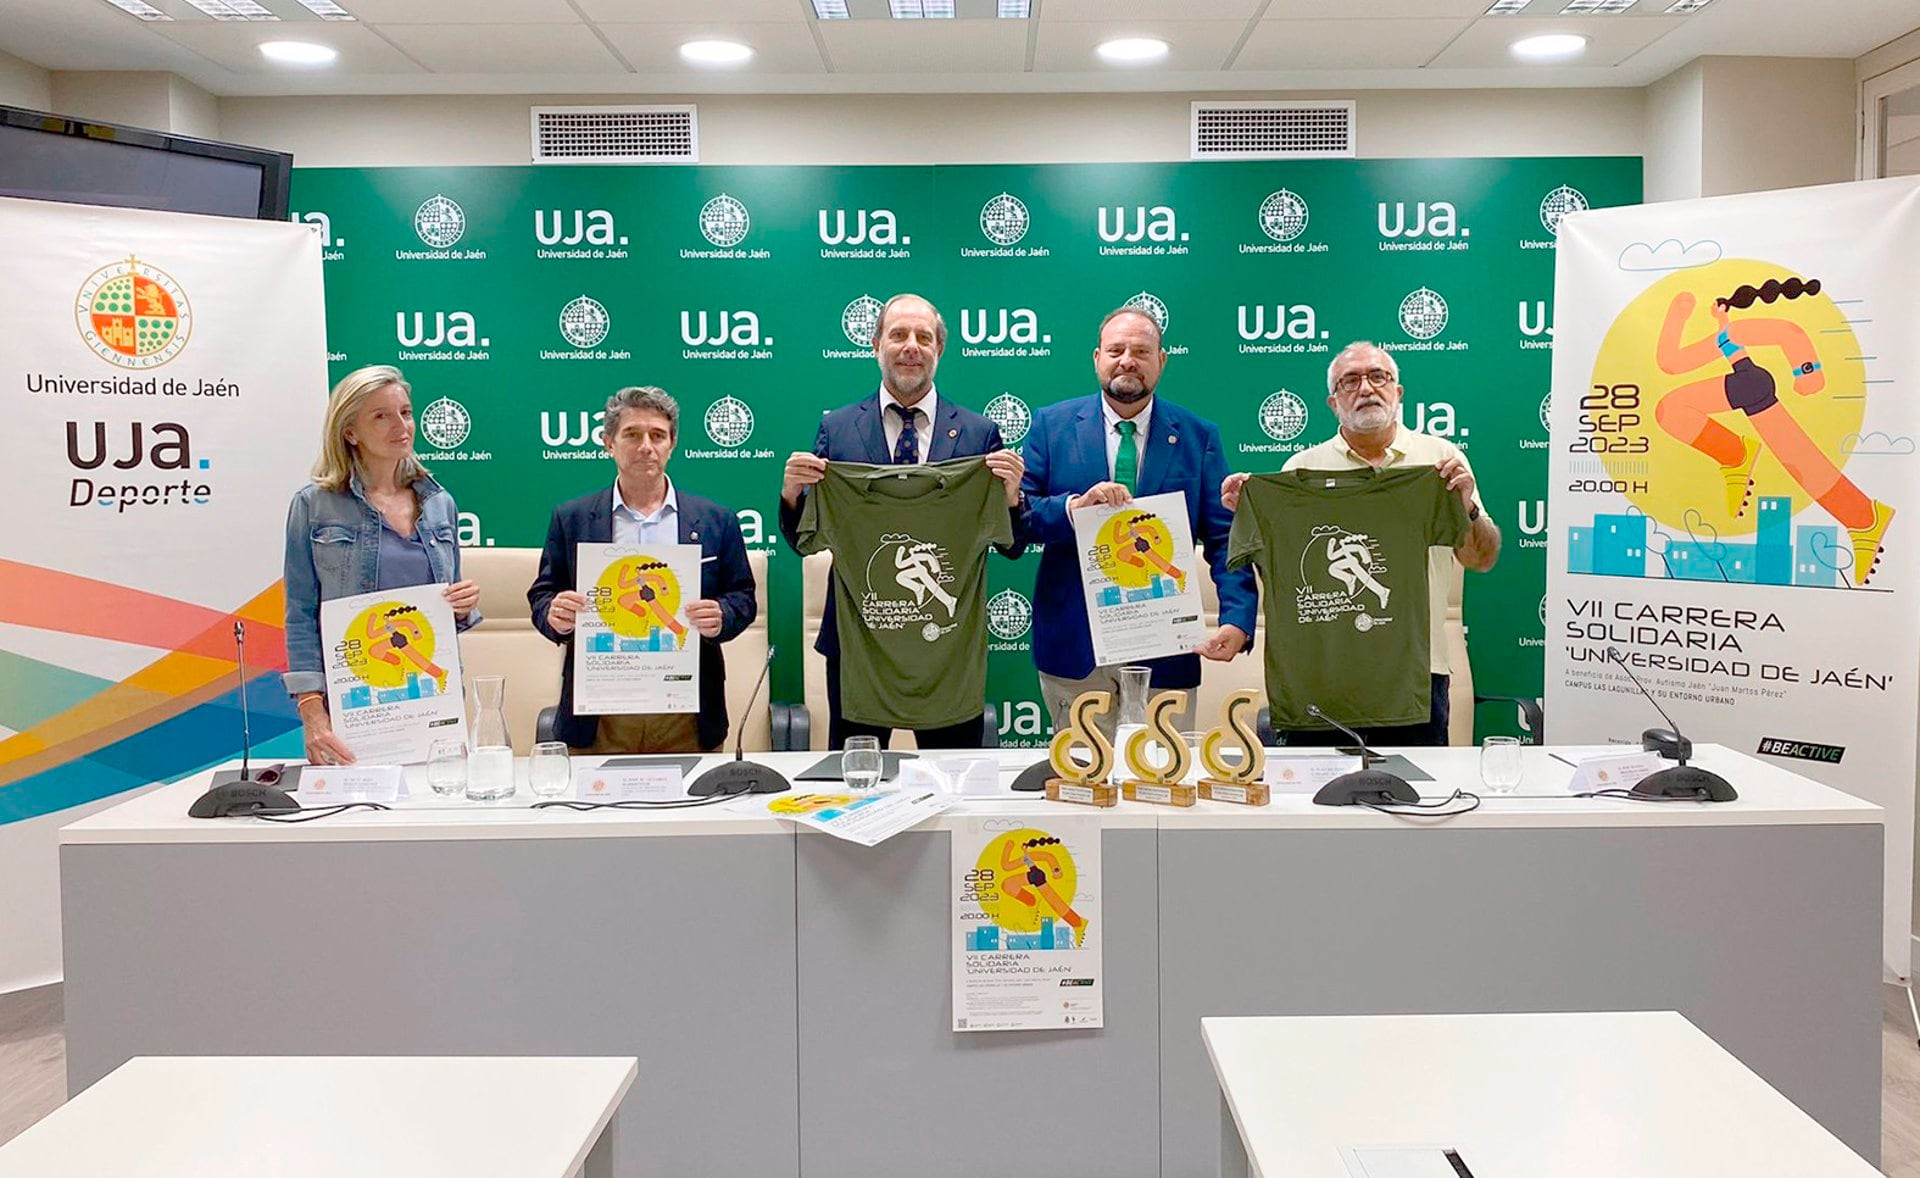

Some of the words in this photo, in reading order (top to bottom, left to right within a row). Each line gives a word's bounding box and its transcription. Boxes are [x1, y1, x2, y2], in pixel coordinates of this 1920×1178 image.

[1100, 246, 1152, 255] Universidad
[1153, 246, 1165, 254] de
[1167, 245, 1188, 254] Jaén
[1239, 243, 1292, 253] Universidad
[1293, 244, 1305, 252] de
[1307, 243, 1328, 252] Jaén
[1379, 241, 1432, 250] Universidad
[1434, 241, 1445, 250] de
[1447, 240, 1468, 250] Jaén
[396, 249, 449, 259] Universidad
[451, 250, 463, 259] de
[464, 250, 486, 259] Jaén
[537, 249, 591, 258] Universidad
[592, 250, 604, 258] de
[606, 249, 627, 258] Jaén
[680, 248, 734, 258] Universidad
[735, 249, 747, 258] de
[748, 249, 770, 258] Jaén
[821, 249, 874, 258] Universidad
[875, 249, 886, 258] de
[888, 249, 910, 258] Jaén
[961, 247, 1014, 256] Universidad
[1015, 248, 1026, 256] de
[1028, 247, 1049, 256] Jaén
[1168, 345, 1188, 354] Jaén
[1239, 344, 1292, 353] Universidad
[1293, 344, 1305, 352] de
[1307, 343, 1328, 352] Jaén
[1379, 341, 1432, 351] Universidad
[1433, 342, 1445, 350] de
[1447, 341, 1468, 350] Jaén
[399, 351, 452, 360] Universidad
[453, 351, 466, 360] de
[467, 351, 489, 360] Jaén
[540, 350, 594, 359] Universidad
[595, 350, 607, 359] de
[609, 350, 630, 359] Jaén
[683, 350, 736, 359] Universidad
[737, 350, 749, 359] de
[751, 350, 772, 358] Jaén
[962, 348, 1014, 357] Universidad
[1015, 348, 1027, 356] de
[1029, 348, 1050, 356] Jaén
[27, 374, 156, 395] Universidad
[163, 378, 187, 396] de
[192, 378, 240, 397] Jaén
[1580, 384, 1640, 409] 28
[1579, 414, 1640, 432] SEP
[1239, 443, 1292, 453] Universidad
[1569, 437, 1649, 453] 2023
[457, 451, 467, 460] de
[469, 451, 491, 460] Jaén
[543, 450, 597, 459] Universidad
[599, 450, 609, 459] de
[685, 448, 738, 458] Universidad
[740, 449, 751, 458] de
[753, 449, 774, 458] Jaén
[1569, 480, 1627, 493] 20.00
[1633, 481, 1648, 493] H
[70, 478, 212, 513] Deporte
[1088, 544, 1111, 557] 28
[586, 587, 612, 597] 28
[1296, 585, 1312, 594] VII
[861, 592, 877, 600] VII
[1296, 591, 1347, 602] CARRERA
[862, 600, 915, 608] CARRERA
[1297, 598, 1352, 609] SOLIDARIA
[862, 607, 920, 615] SOLIDARIA
[1567, 598, 1602, 618] VII
[1615, 602, 1785, 632] CARRERA
[1566, 621, 1742, 653] SOLIDARIA
[334, 639, 362, 651] 28
[1019, 641, 1030, 650] de
[1761, 664, 1799, 682] DE
[1656, 677, 1686, 688] Autismo
[1688, 680, 1706, 690] Jaén
[1732, 686, 1758, 696] Martos
[1565, 680, 1592, 690] CAMPUS
[1594, 682, 1607, 691] LAS
[1657, 689, 1668, 698] SU
[1669, 691, 1702, 702] ENTORNO
[1704, 695, 1736, 706] URBANO
[1761, 740, 1841, 761] #BEACTIVE
[730, 769, 762, 778] BOSCH
[231, 789, 266, 798] BOSCH
[964, 869, 994, 881] 28
[964, 883, 994, 892] SEP
[960, 893, 999, 902] 2023
[981, 953, 1030, 961] CARRERA
